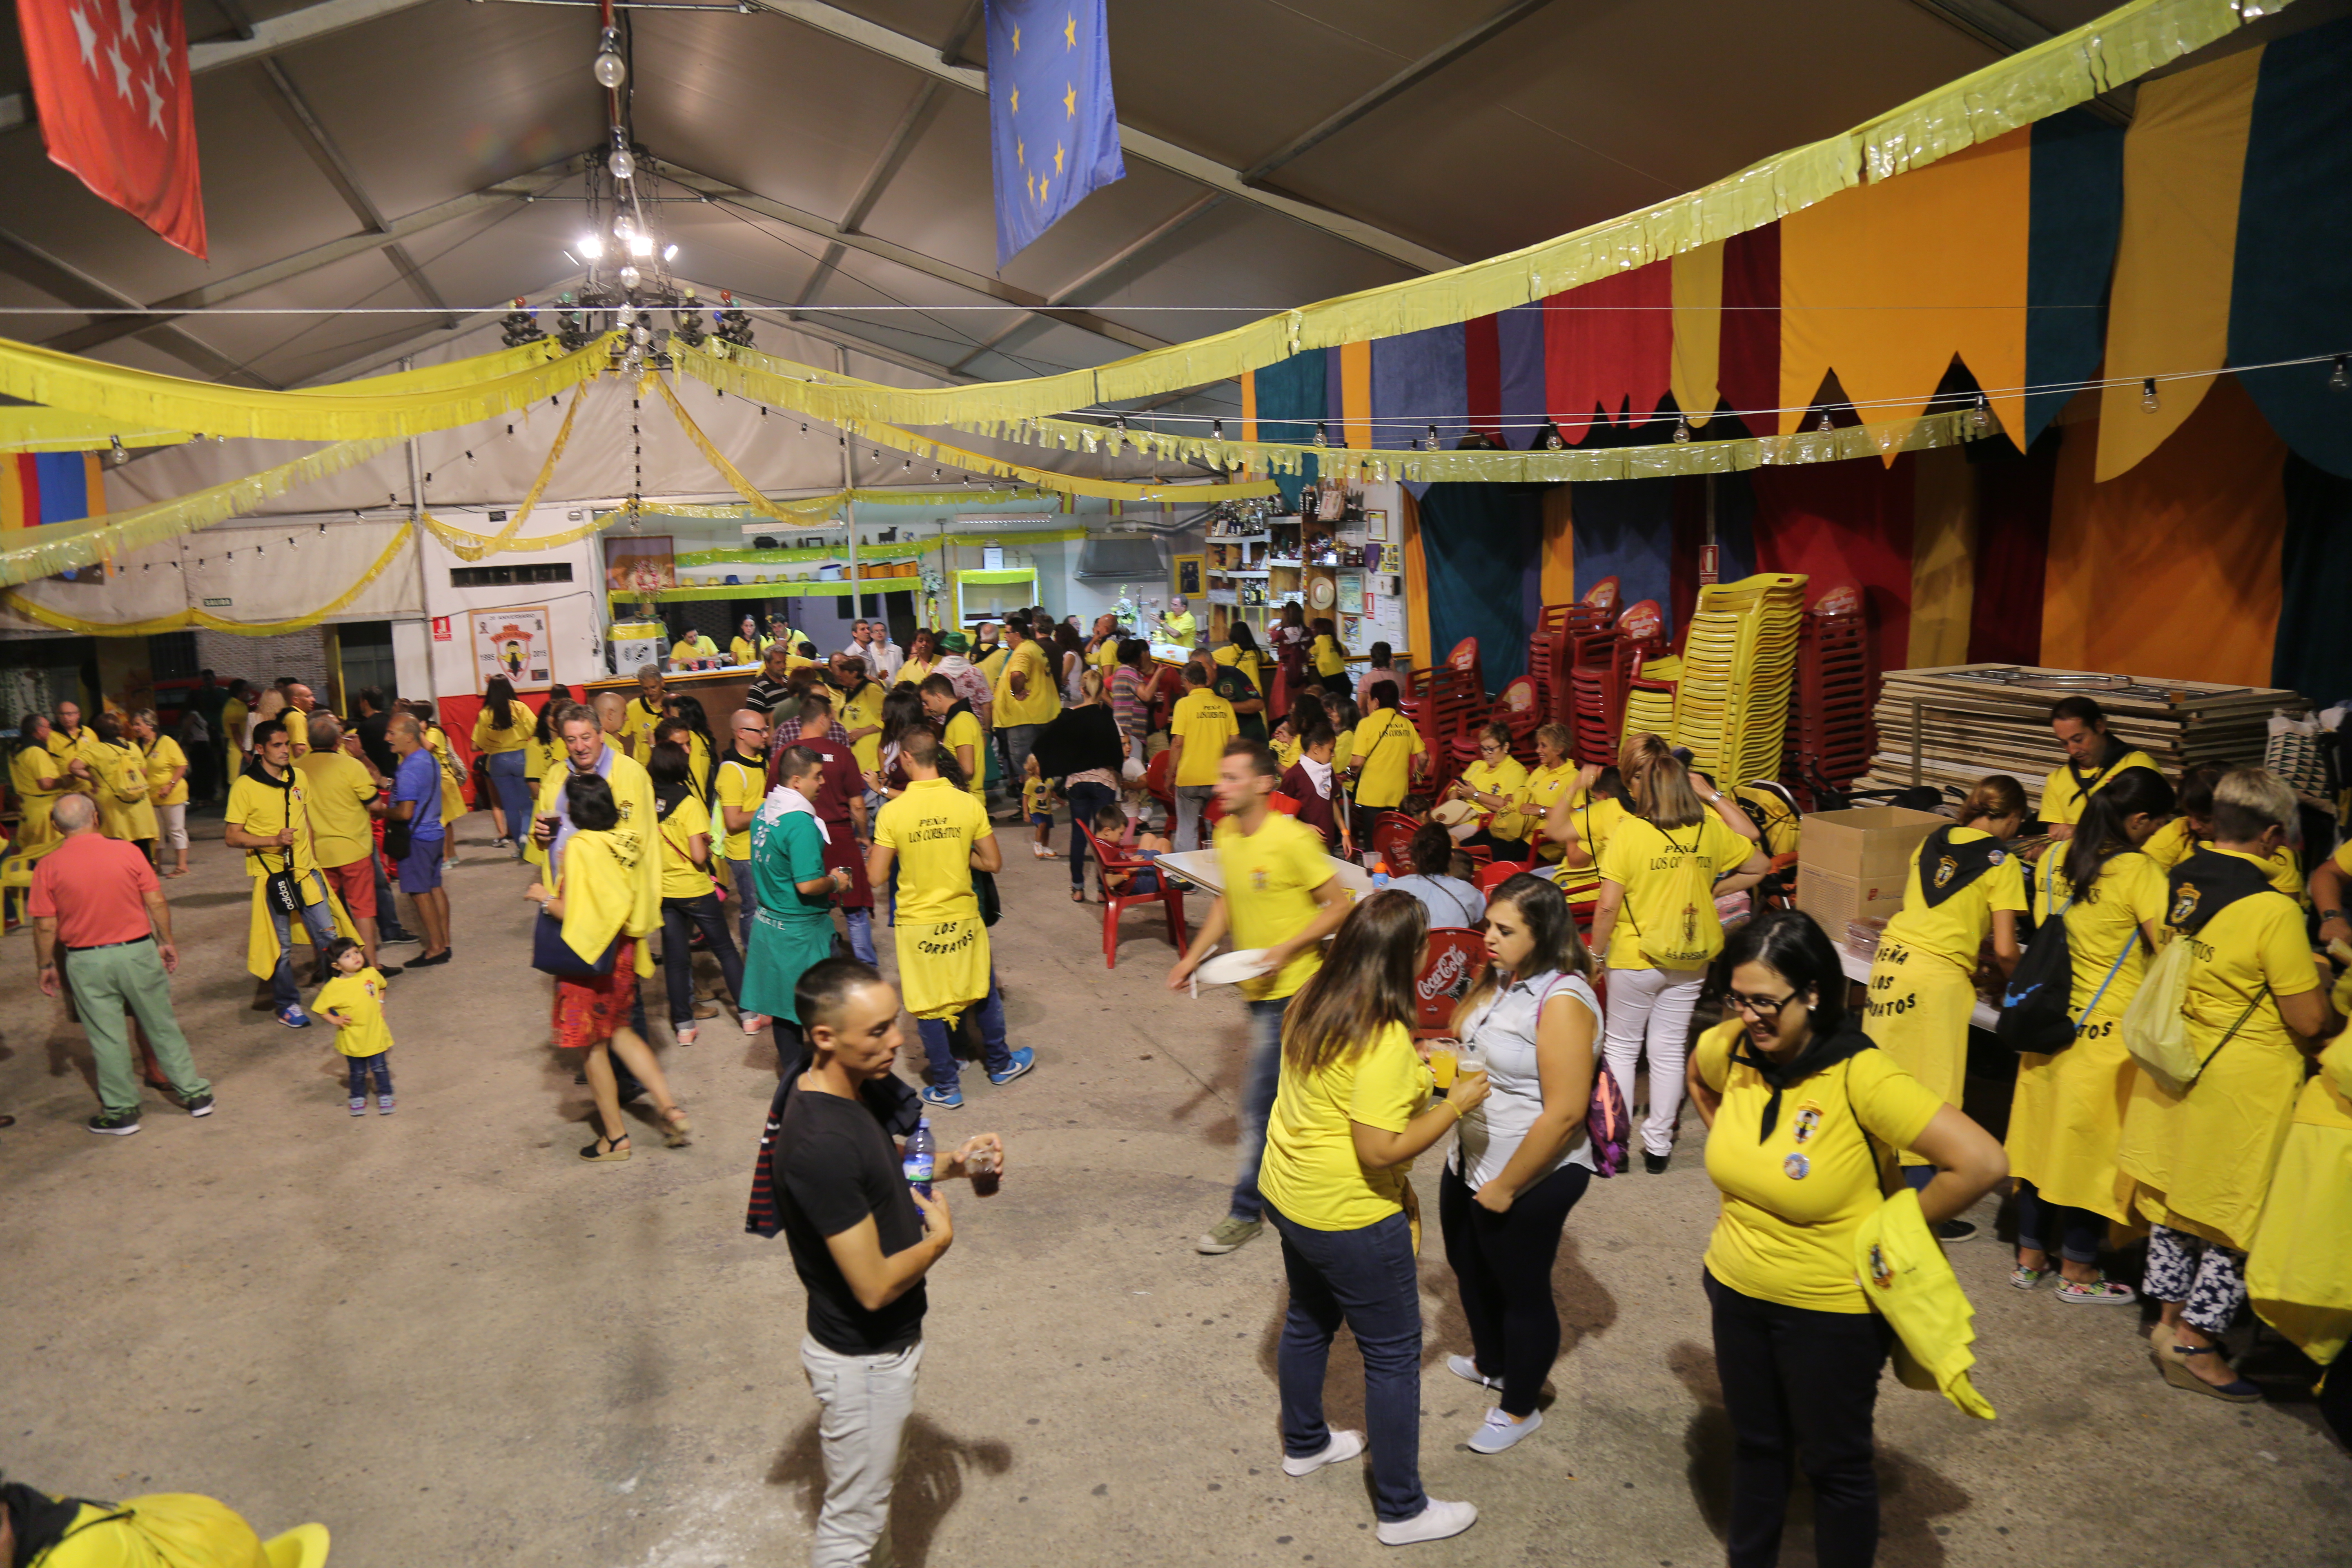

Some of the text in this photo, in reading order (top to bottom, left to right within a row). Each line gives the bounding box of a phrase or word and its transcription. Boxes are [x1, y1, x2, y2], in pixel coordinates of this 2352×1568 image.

[919, 815, 948, 827] PEÑA
[908, 826, 961, 843] LOS CORBATOS
[1664, 843, 1699, 853] PEÑA
[1650, 857, 1668, 870] LOS
[278, 880, 294, 910] adidas
[934, 922, 957, 935] LOS
[918, 929, 973, 954] CORBATOS
[1872, 975, 1894, 990] LOS
